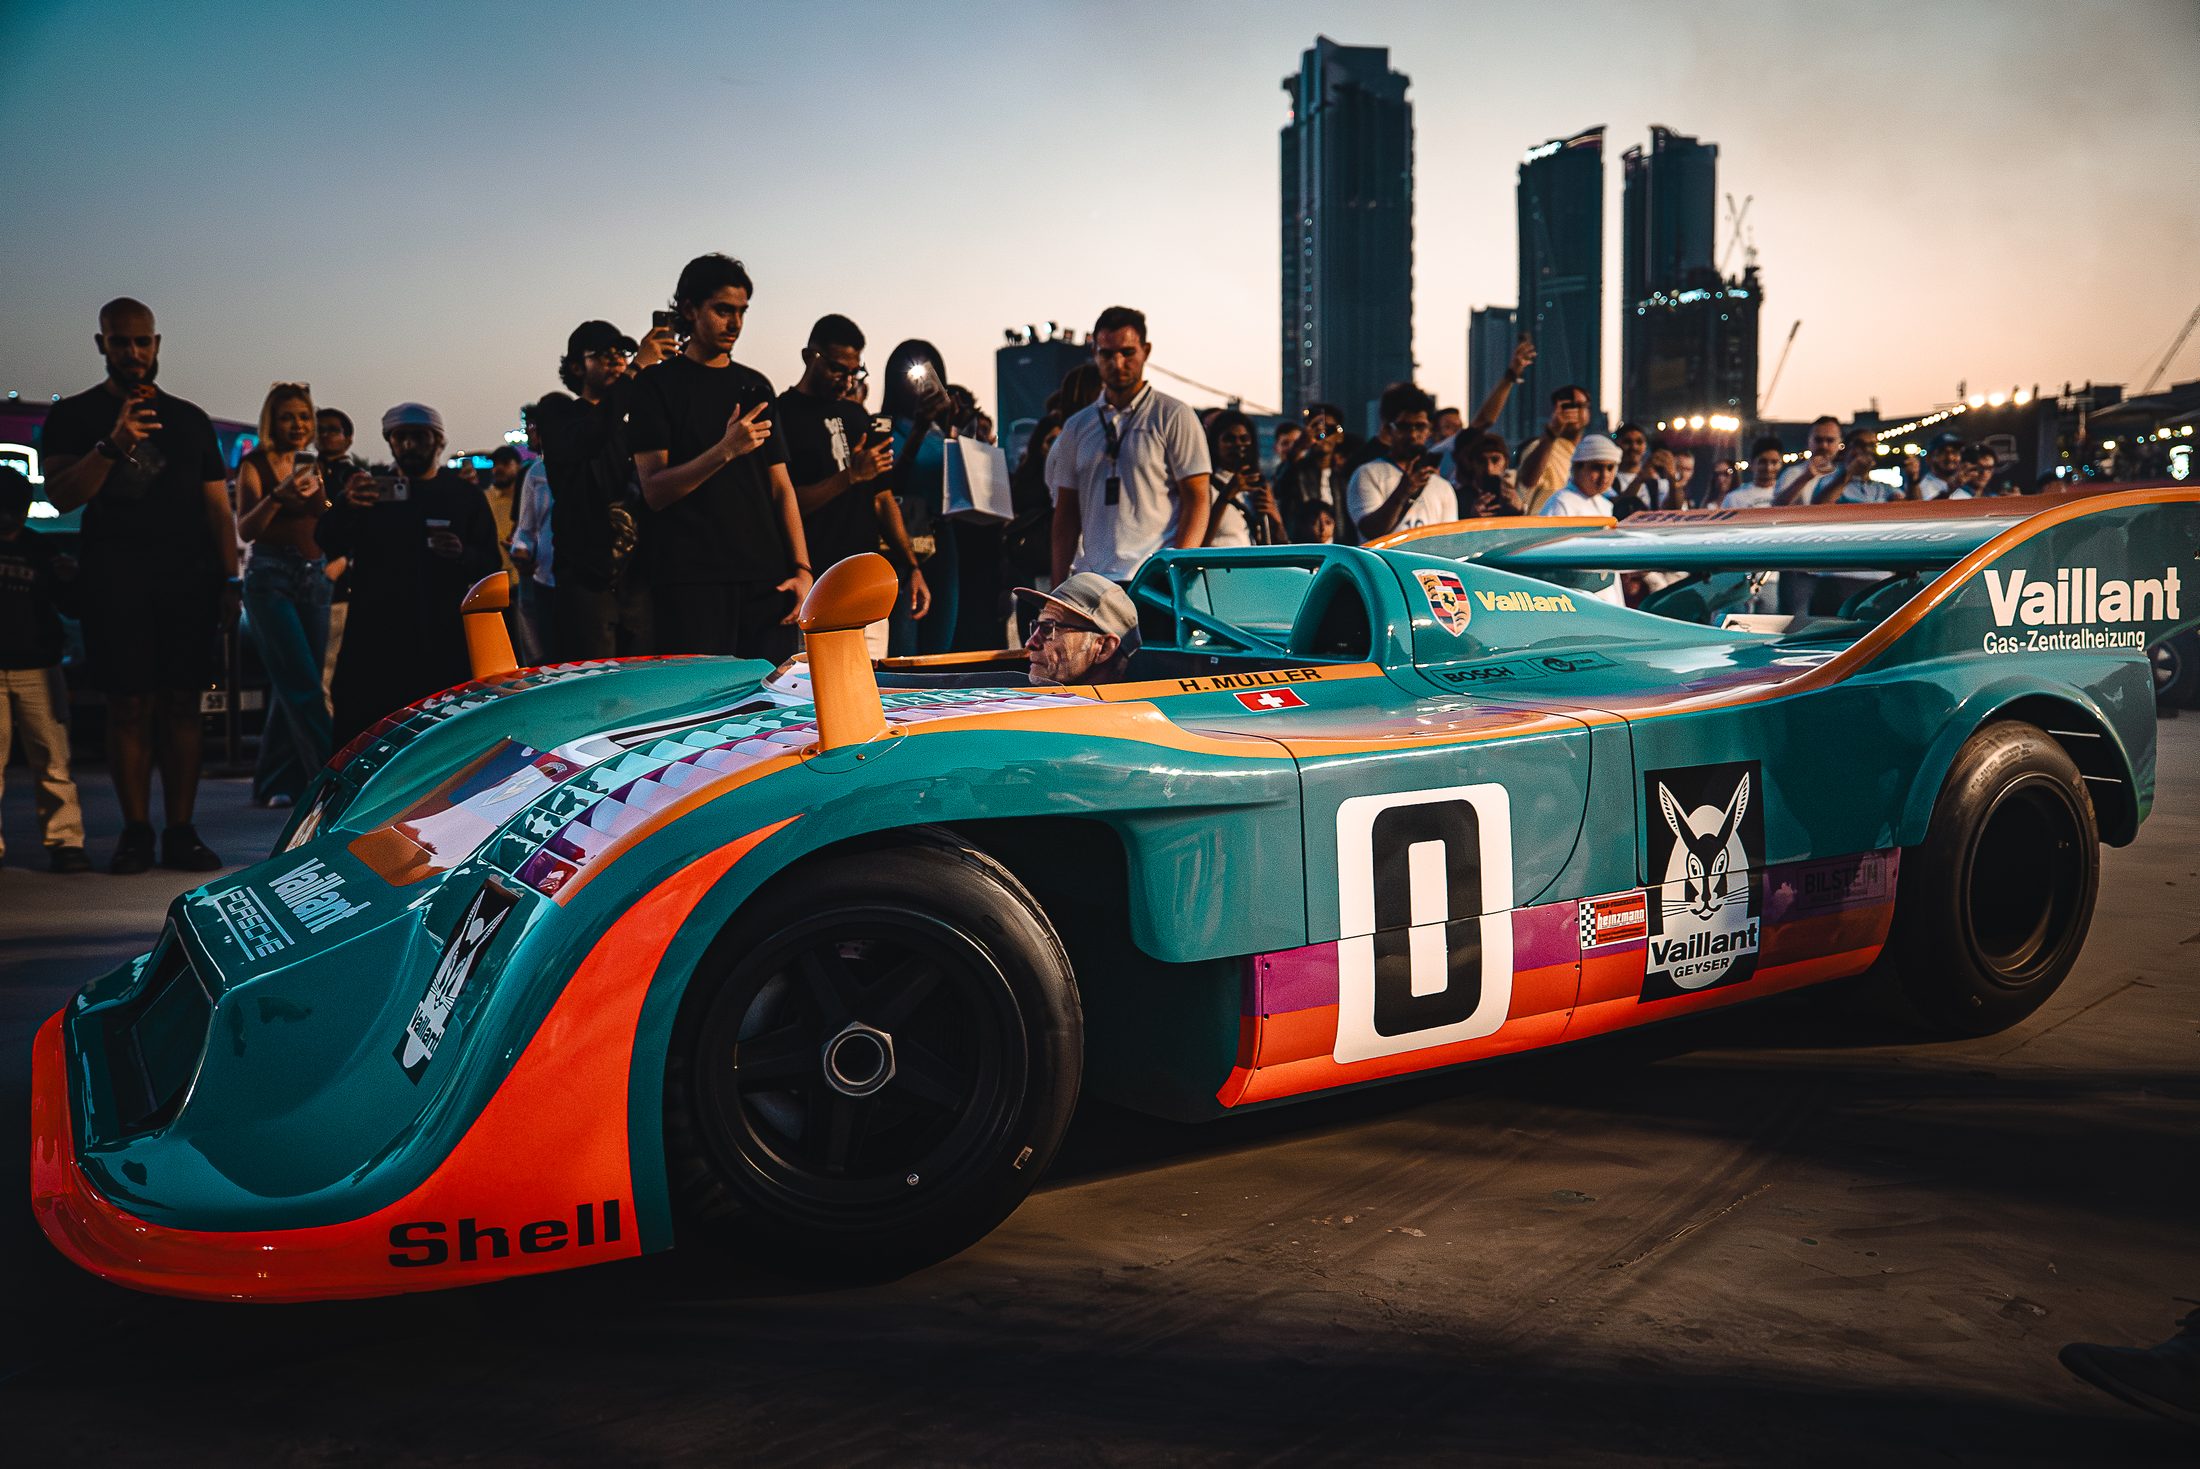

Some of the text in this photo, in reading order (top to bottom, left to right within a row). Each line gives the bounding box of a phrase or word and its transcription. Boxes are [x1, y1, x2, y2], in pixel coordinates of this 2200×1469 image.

[1474, 590, 1577, 613] Vaillant
[1982, 566, 2181, 628] Vaillant
[1982, 627, 2146, 655] Gas-Zentralheizung
[1210, 668, 1322, 689] MÜLLER
[1442, 665, 1516, 683] BOSCH
[268, 857, 371, 934] Vaillant
[1371, 798, 1482, 1038] 0
[223, 889, 285, 958] PORSCHE
[1650, 922, 1758, 967] Vaillant
[1673, 957, 1730, 979] GEYSER
[410, 1005, 443, 1055] Vaillant
[388, 1199, 621, 1268] Shell
